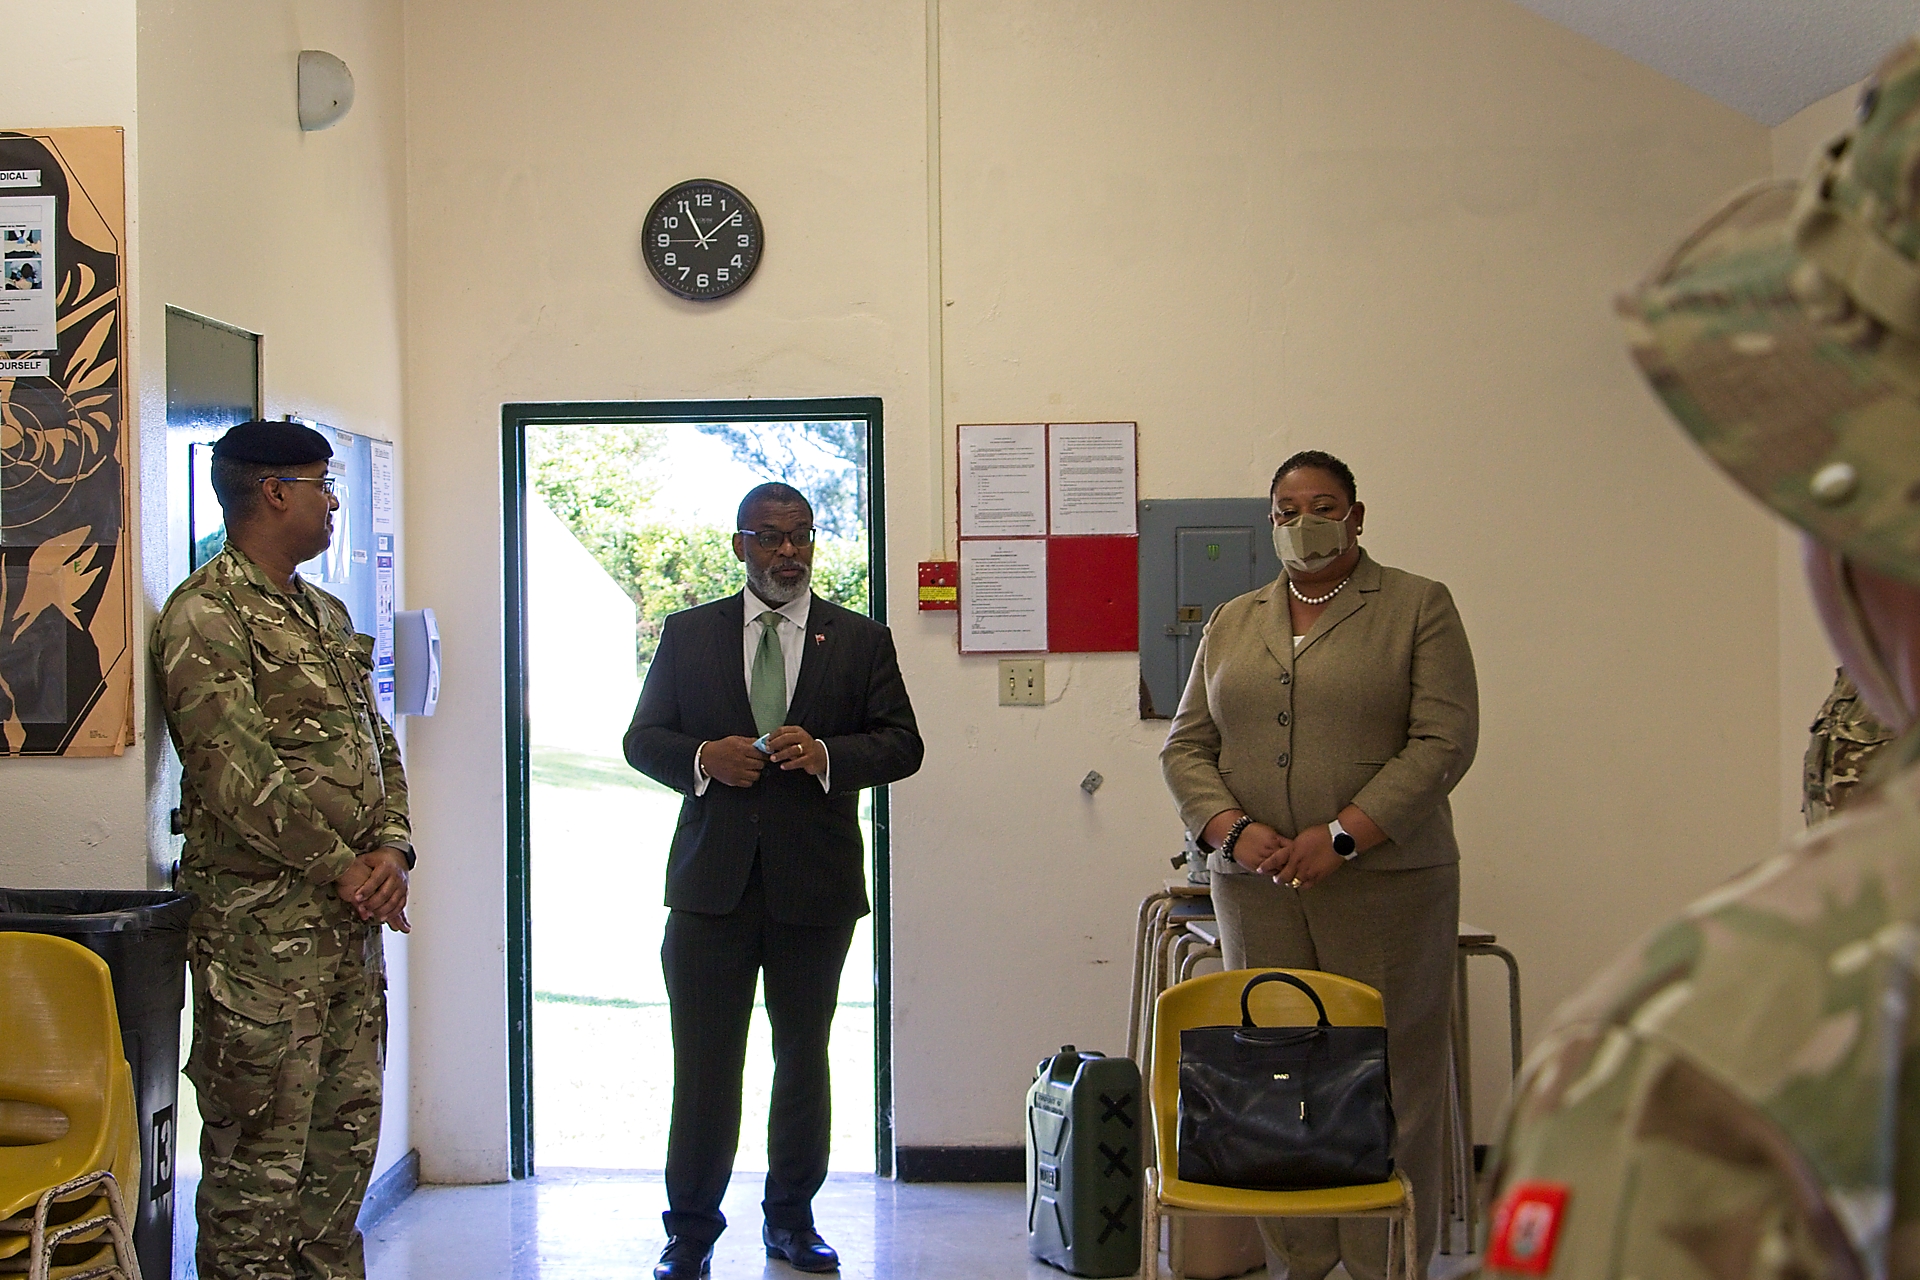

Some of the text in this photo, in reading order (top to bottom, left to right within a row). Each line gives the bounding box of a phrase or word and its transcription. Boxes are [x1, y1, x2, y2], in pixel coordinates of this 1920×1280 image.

[0, 172, 28, 181] DICAL
[695, 194, 712, 206] 12
[720, 199, 727, 212] 1
[677, 201, 690, 213] 11
[662, 216, 678, 229] 10
[731, 214, 742, 227] 2
[657, 233, 670, 247] 9
[737, 234, 748, 247] 3
[664, 252, 676, 266] 8
[731, 254, 743, 268] 4
[678, 266, 690, 281] 7
[697, 273, 709, 287] 6
[717, 268, 729, 281] 5
[153, 1119, 171, 1187] 13
